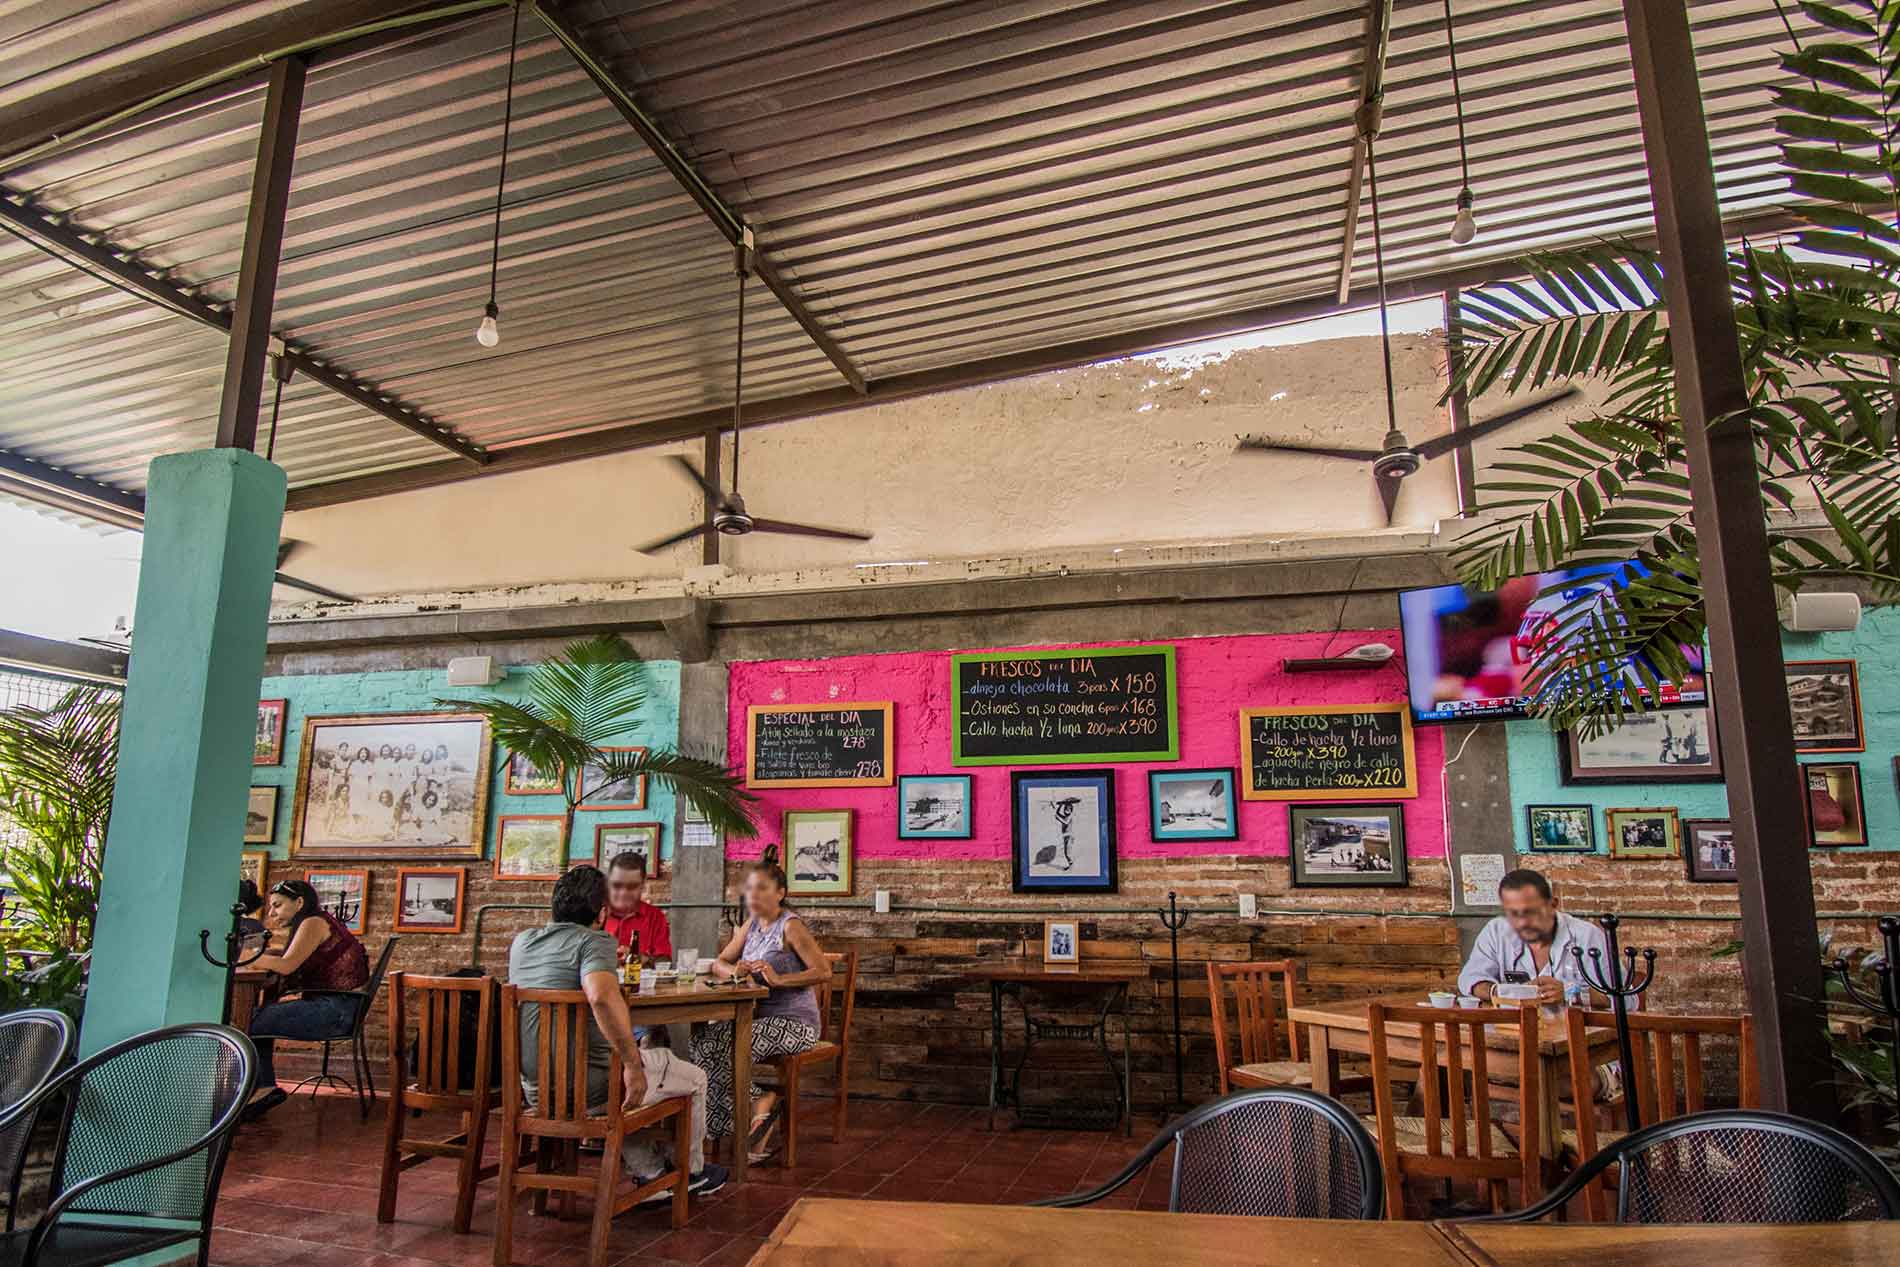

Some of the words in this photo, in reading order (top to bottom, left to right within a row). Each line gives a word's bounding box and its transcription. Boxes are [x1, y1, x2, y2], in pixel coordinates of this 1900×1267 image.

[980, 659, 1041, 678] FRESCOS
[1071, 658, 1097, 678] DIA
[1126, 672, 1157, 694] 158
[970, 700, 1020, 716] Ostiones
[1026, 704, 1040, 716] en
[1058, 701, 1095, 716] concha
[1131, 697, 1157, 716] 168
[764, 712, 816, 726] ESPECIAL
[820, 712, 835, 721] DEL
[840, 711, 862, 728] DIA
[968, 721, 997, 737] Callo
[1002, 720, 1034, 737] hacha
[1058, 718, 1082, 737] luna
[1264, 715, 1329, 731] FRESCOS
[1353, 713, 1380, 730] DIA
[816, 729, 824, 737] a
[825, 723, 834, 737] la
[1260, 731, 1288, 746] Callo
[1292, 732, 1307, 746] de
[1308, 729, 1345, 748] hacha
[1369, 729, 1397, 746] luna
[842, 735, 867, 749] 278
[857, 759, 882, 778] 278
[1320, 758, 1352, 775] negro
[1354, 753, 1367, 768] de
[1370, 752, 1399, 768] callo
[1255, 771, 1268, 787] de
